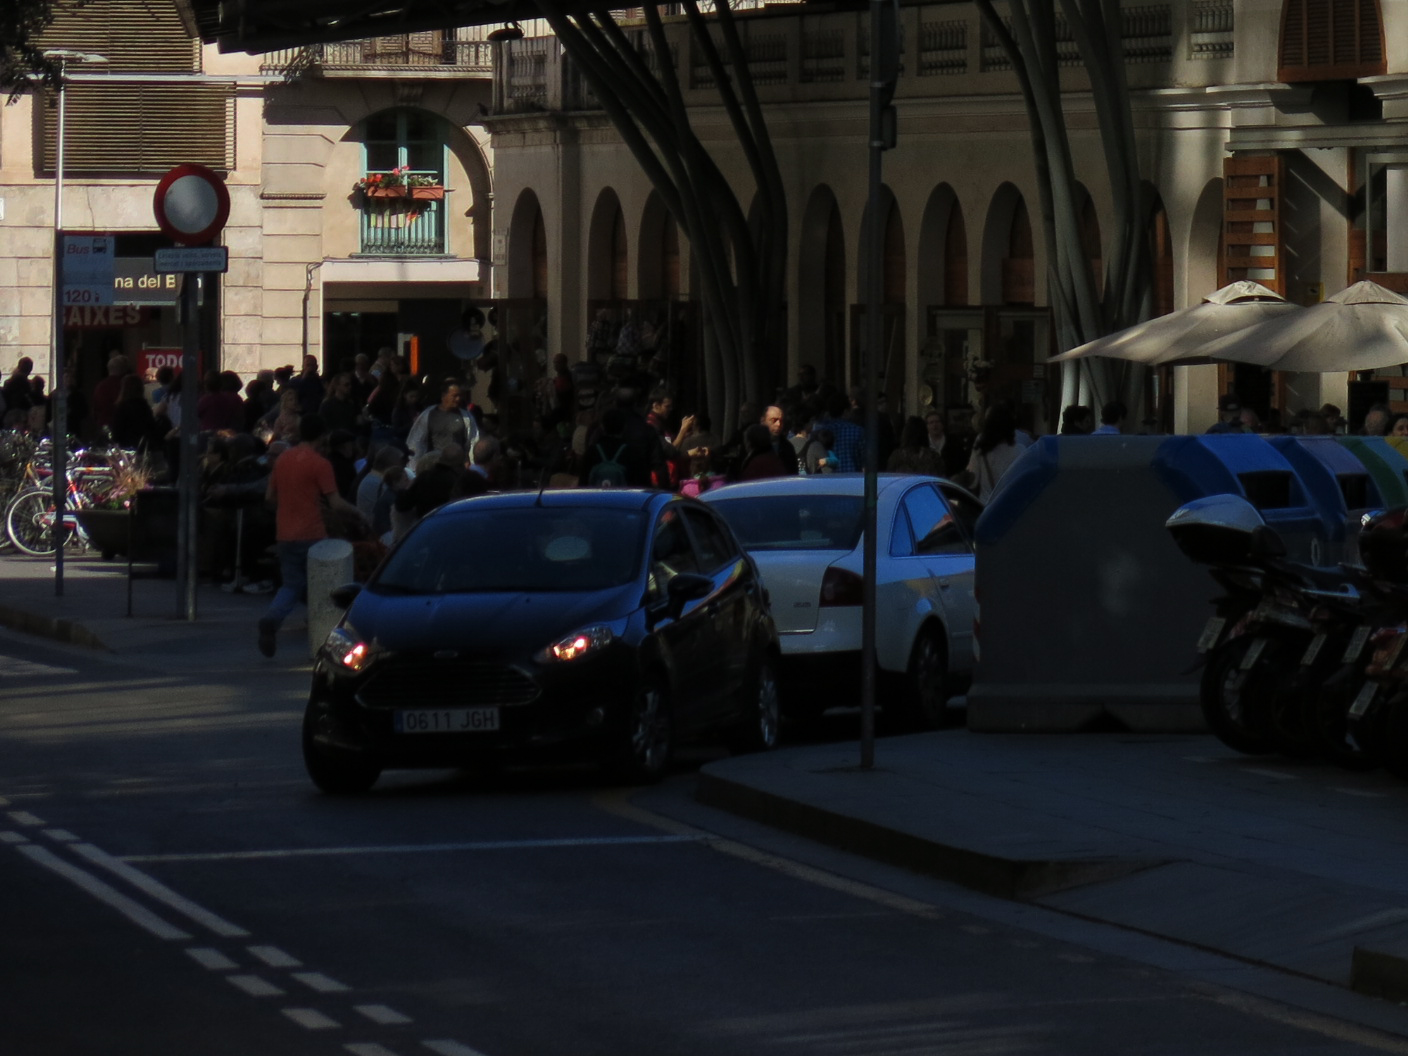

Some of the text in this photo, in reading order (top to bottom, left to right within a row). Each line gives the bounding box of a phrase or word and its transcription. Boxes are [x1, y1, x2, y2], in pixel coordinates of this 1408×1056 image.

[66, 244, 89, 254] Bus
[138, 274, 161, 289] del
[66, 289, 91, 302] 120
[62, 304, 141, 326] AIXES
[406, 709, 495, 730] 0611 JGH
